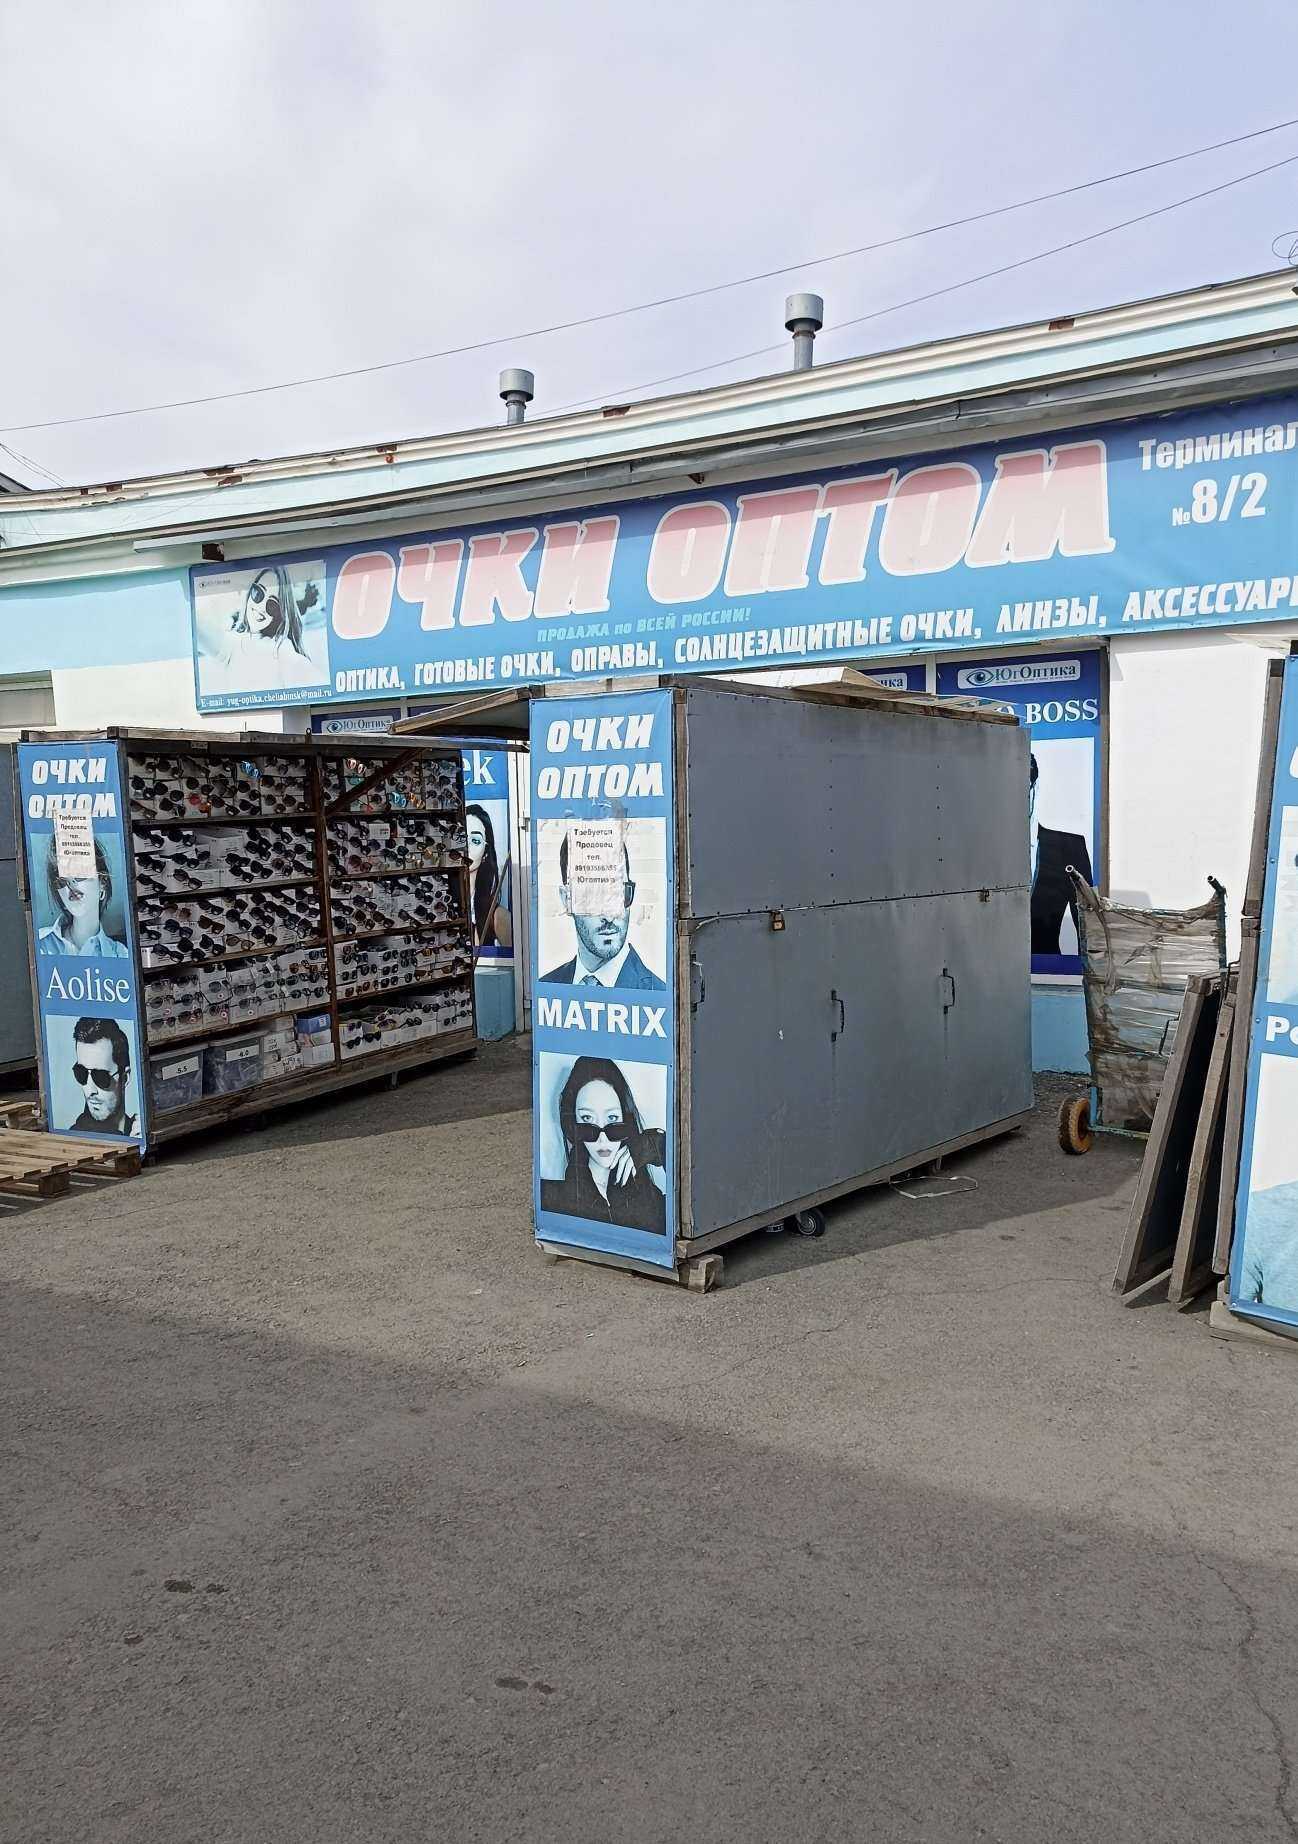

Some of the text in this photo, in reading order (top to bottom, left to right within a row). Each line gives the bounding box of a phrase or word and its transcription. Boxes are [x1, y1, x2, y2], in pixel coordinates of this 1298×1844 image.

[1139, 421, 1298, 471] Терминал
[332, 439, 1116, 640] ОЧКИ ОПТОМ
[537, 607, 752, 643] ПРОДАЖА по ВСЕЙ РОССИИ!
[335, 666, 405, 693] ОПТИКА,
[415, 656, 496, 686] ГОТОВЫЕ
[501, 651, 561, 678] ОЧКИ,
[571, 641, 664, 673] ОПРАВЫ,
[675, 617, 892, 664] СОЛНЦЕЗАЩИТНЫЕ
[900, 608, 982, 641] ОЧКИ,
[996, 595, 1107, 634] ЛИНЗЫ,
[995, 665, 1076, 681] ЮгОптика
[1024, 699, 1098, 724] BOSS
[545, 714, 655, 753] ОЧКИ
[31, 758, 107, 785] ОЧКИ
[537, 762, 664, 799] ОПТОМ
[28, 793, 117, 819] ОПТОМ
[46, 967, 131, 1003] Aolise
[537, 997, 668, 1039] MATRIX
